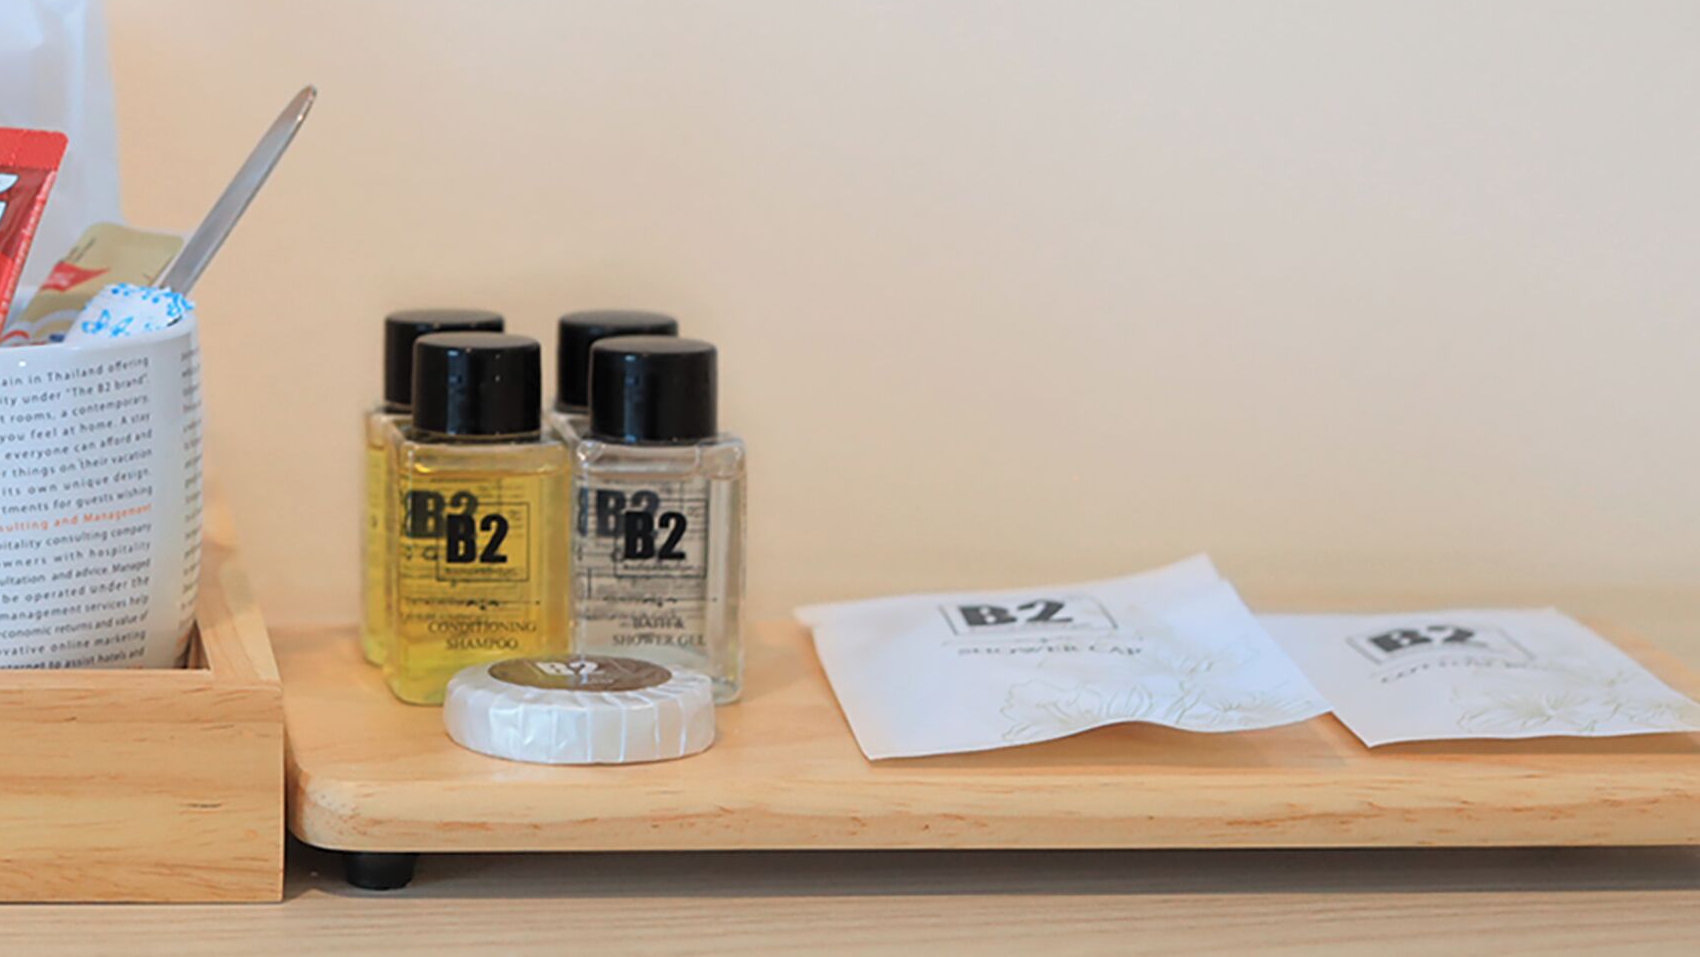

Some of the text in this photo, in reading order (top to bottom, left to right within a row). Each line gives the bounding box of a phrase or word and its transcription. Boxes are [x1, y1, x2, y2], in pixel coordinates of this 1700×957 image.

[47, 364, 103, 382] Thailand
[21, 391, 60, 404] under
[29, 426, 57, 438] feel
[4, 445, 69, 459] everyone
[73, 441, 95, 452] can
[11, 465, 55, 477] things
[27, 483, 58, 494] own
[63, 475, 108, 490] unique
[52, 498, 71, 509] for
[53, 514, 78, 527] and
[446, 513, 510, 563] B2
[624, 511, 688, 560] B2
[957, 599, 1074, 627] B2
[445, 636, 519, 651] SHAMPOO
[1367, 624, 1489, 653] B2
